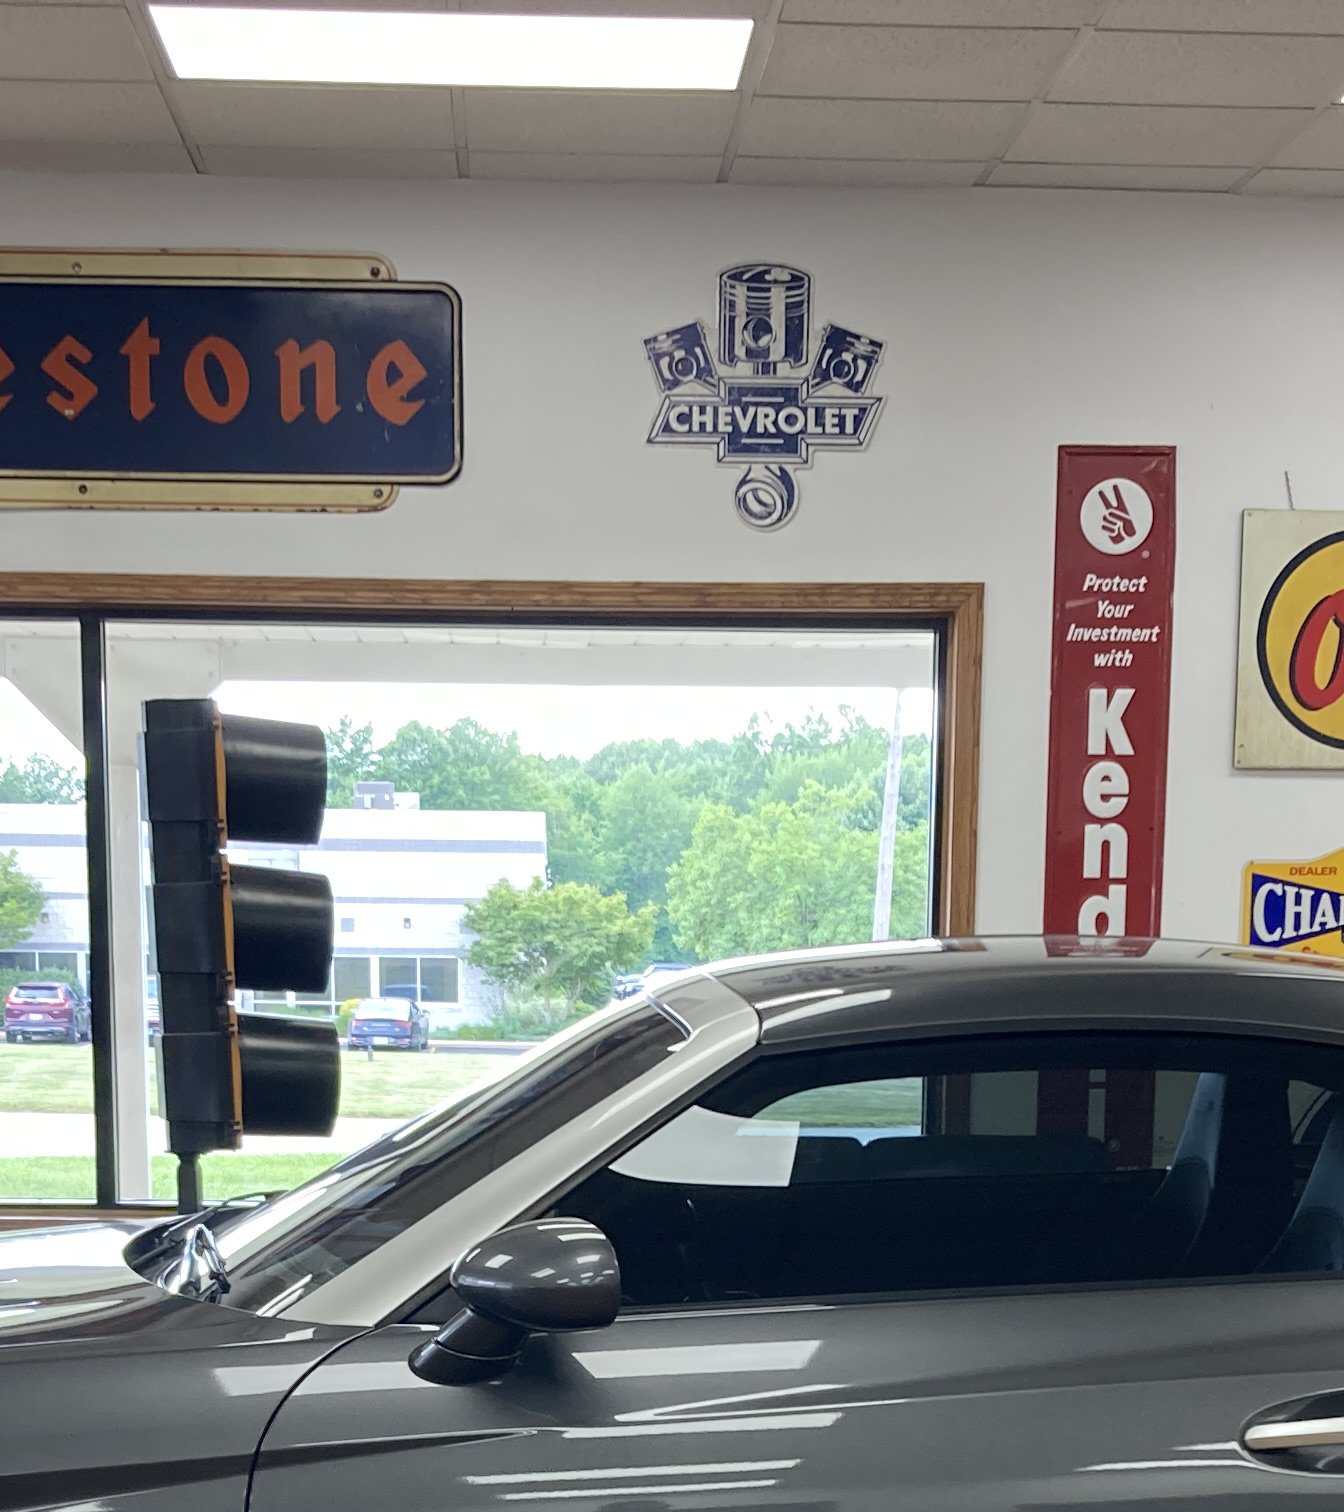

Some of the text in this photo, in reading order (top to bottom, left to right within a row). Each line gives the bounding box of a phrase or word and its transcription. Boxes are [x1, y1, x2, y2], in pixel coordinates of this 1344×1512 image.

[668, 404, 860, 435] CHEVROLET
[1082, 573, 1148, 592] Protect
[1097, 600, 1134, 618] Your
[1066, 623, 1161, 643] Investment
[1094, 648, 1134, 667] with
[1289, 866, 1338, 876] DEALER
